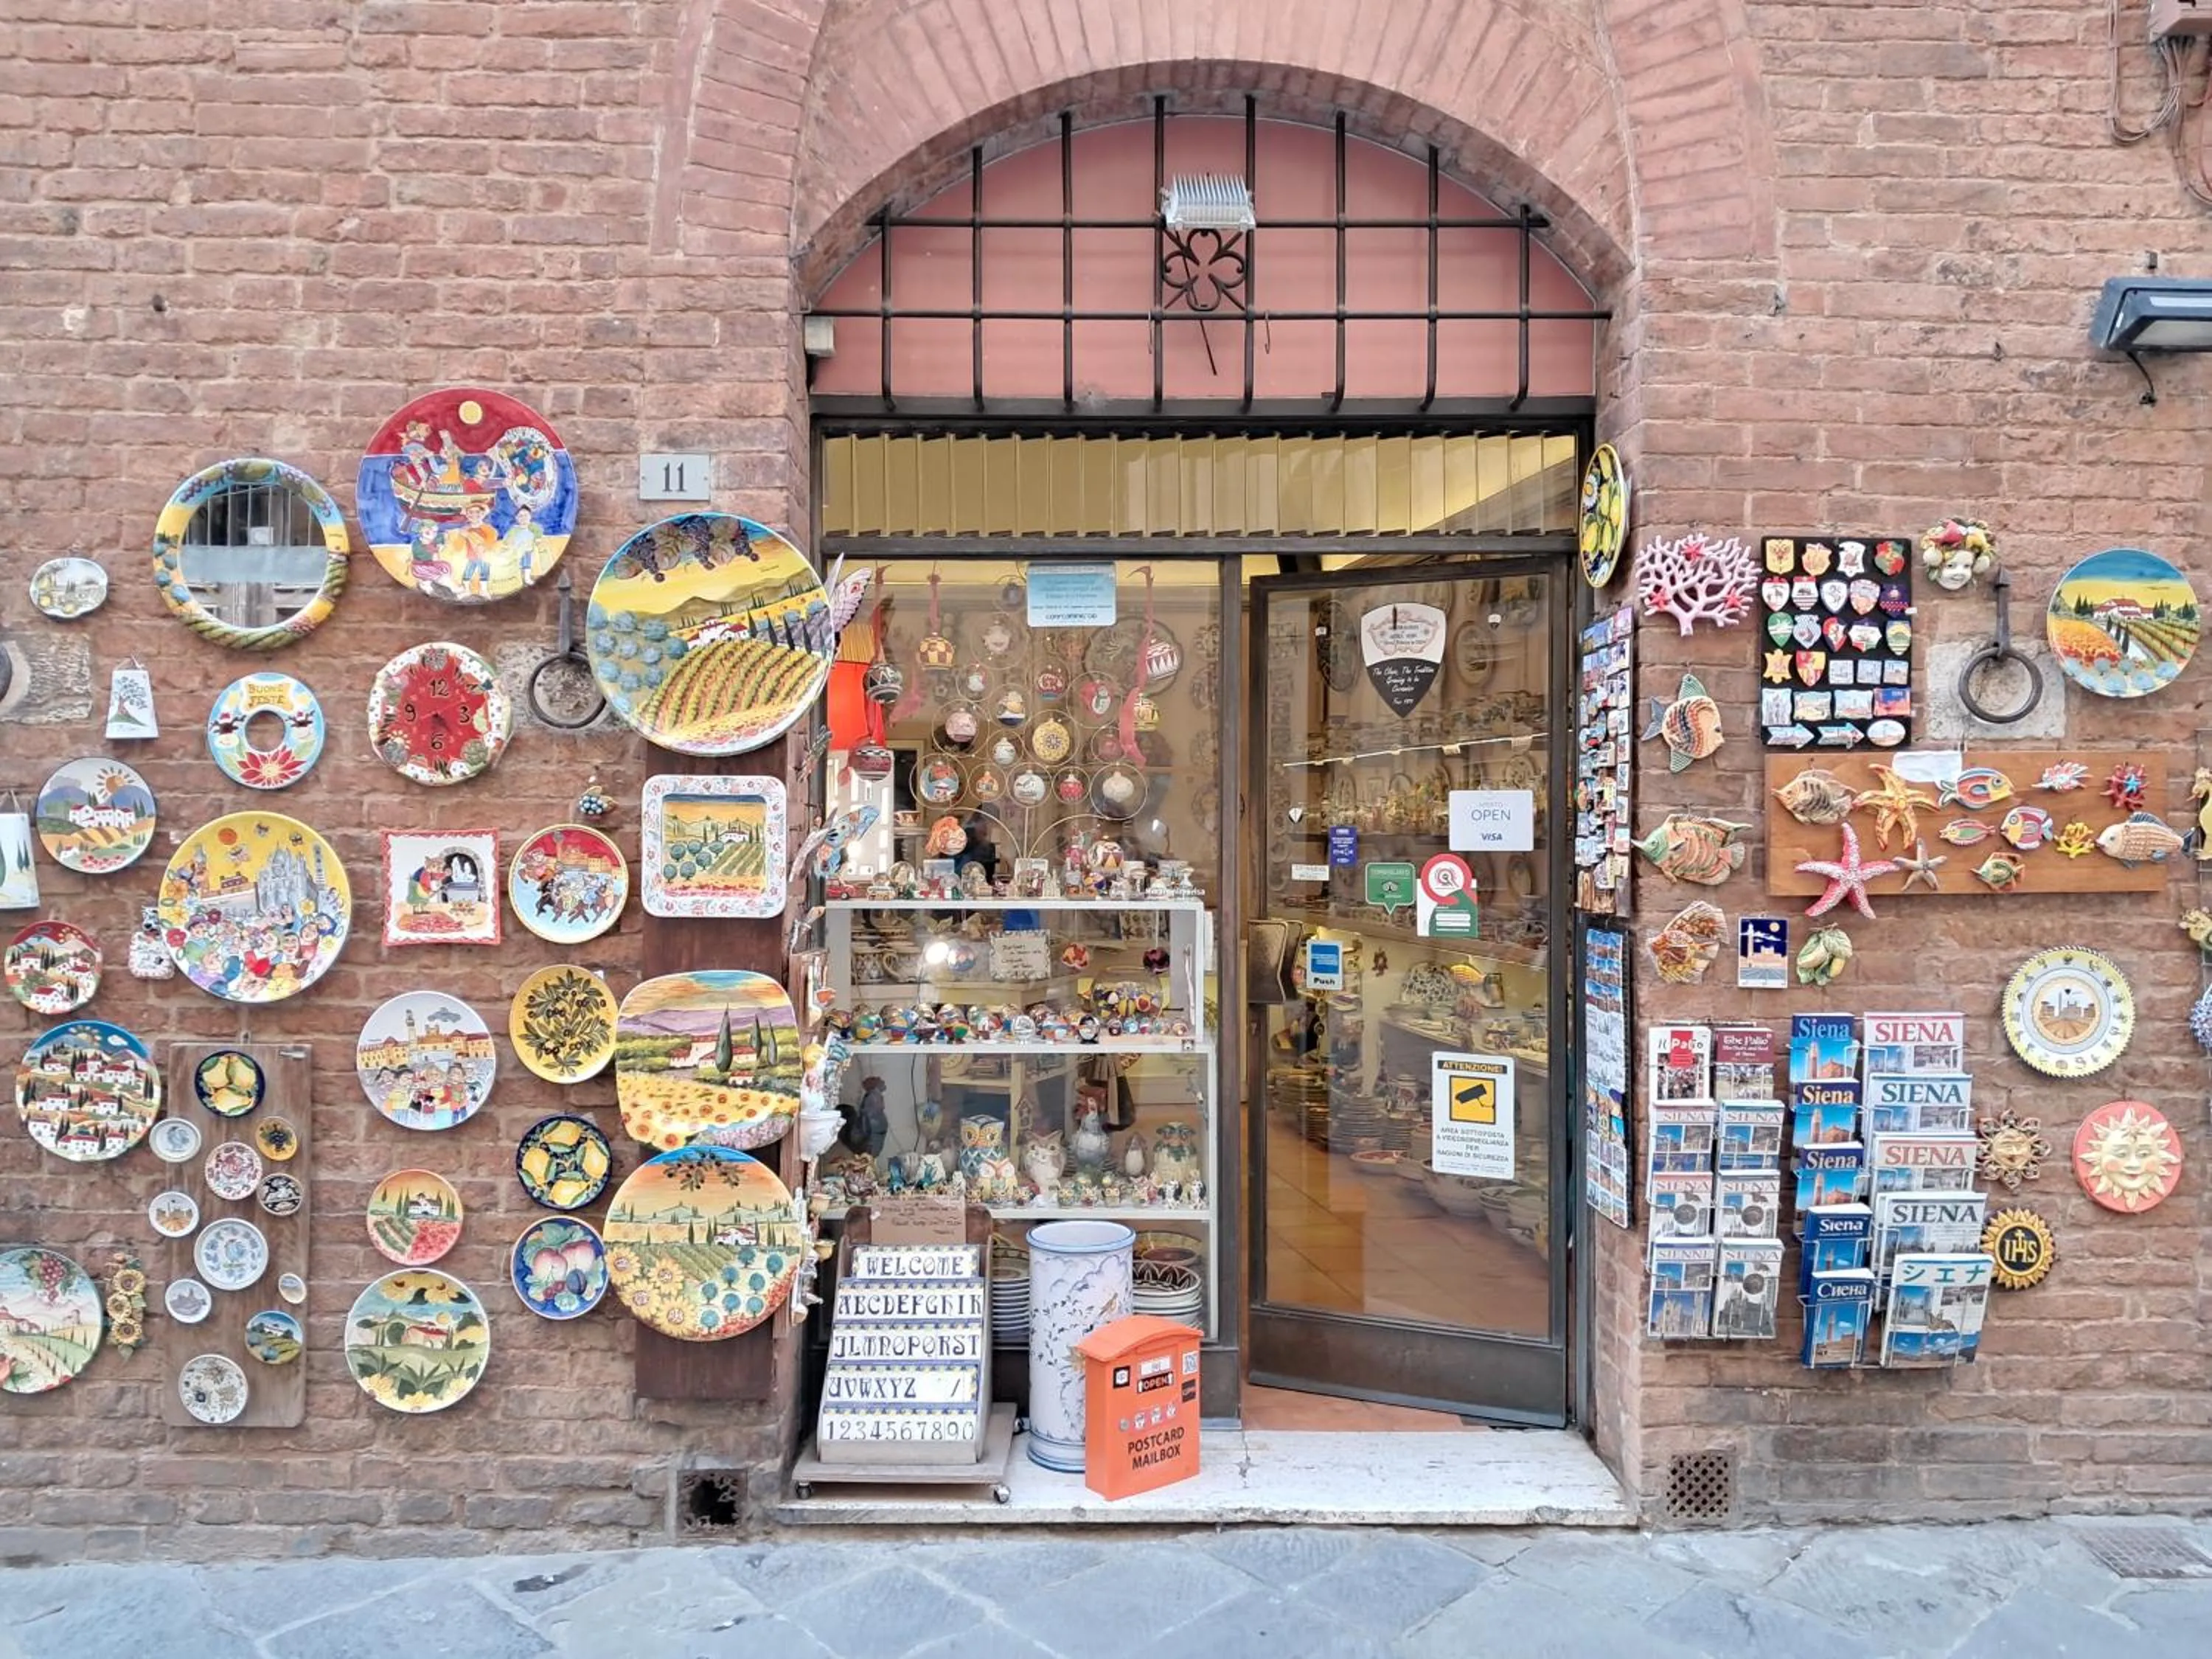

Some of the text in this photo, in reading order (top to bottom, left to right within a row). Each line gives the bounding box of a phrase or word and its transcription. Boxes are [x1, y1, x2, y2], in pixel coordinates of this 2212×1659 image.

[662, 462, 687, 493] 11
[431, 678, 449, 697] 12
[405, 703, 416, 722] 9
[459, 706, 470, 723] 3
[431, 733, 443, 749] 6
[1471, 809, 1511, 821] OPEN
[1481, 832, 1503, 841] VISA
[1798, 1018, 1850, 1038] Siena
[1875, 1022, 1955, 1043] SIENA
[1672, 1038, 1703, 1050] Palio
[1802, 1085, 1854, 1105] Siena
[1881, 1082, 1963, 1104] SIENA
[1663, 1111, 1707, 1121] SIENA
[1727, 1112, 1780, 1121] SIENA
[1807, 1151, 1857, 1169] Siena
[1885, 1145, 1967, 1166] SIENA
[1892, 1204, 1978, 1224] SIENA
[1819, 1218, 1863, 1232] Siena
[2004, 1238, 2037, 1262] IHS
[866, 1256, 964, 1276] WELCOME
[1903, 1265, 1986, 1283] シエナ
[1817, 1282, 1867, 1298] Сиена
[1144, 1377, 1168, 1389] OPEN
[1127, 1427, 1185, 1455] POSTCARD
[1132, 1444, 1181, 1470] MAILBOX
